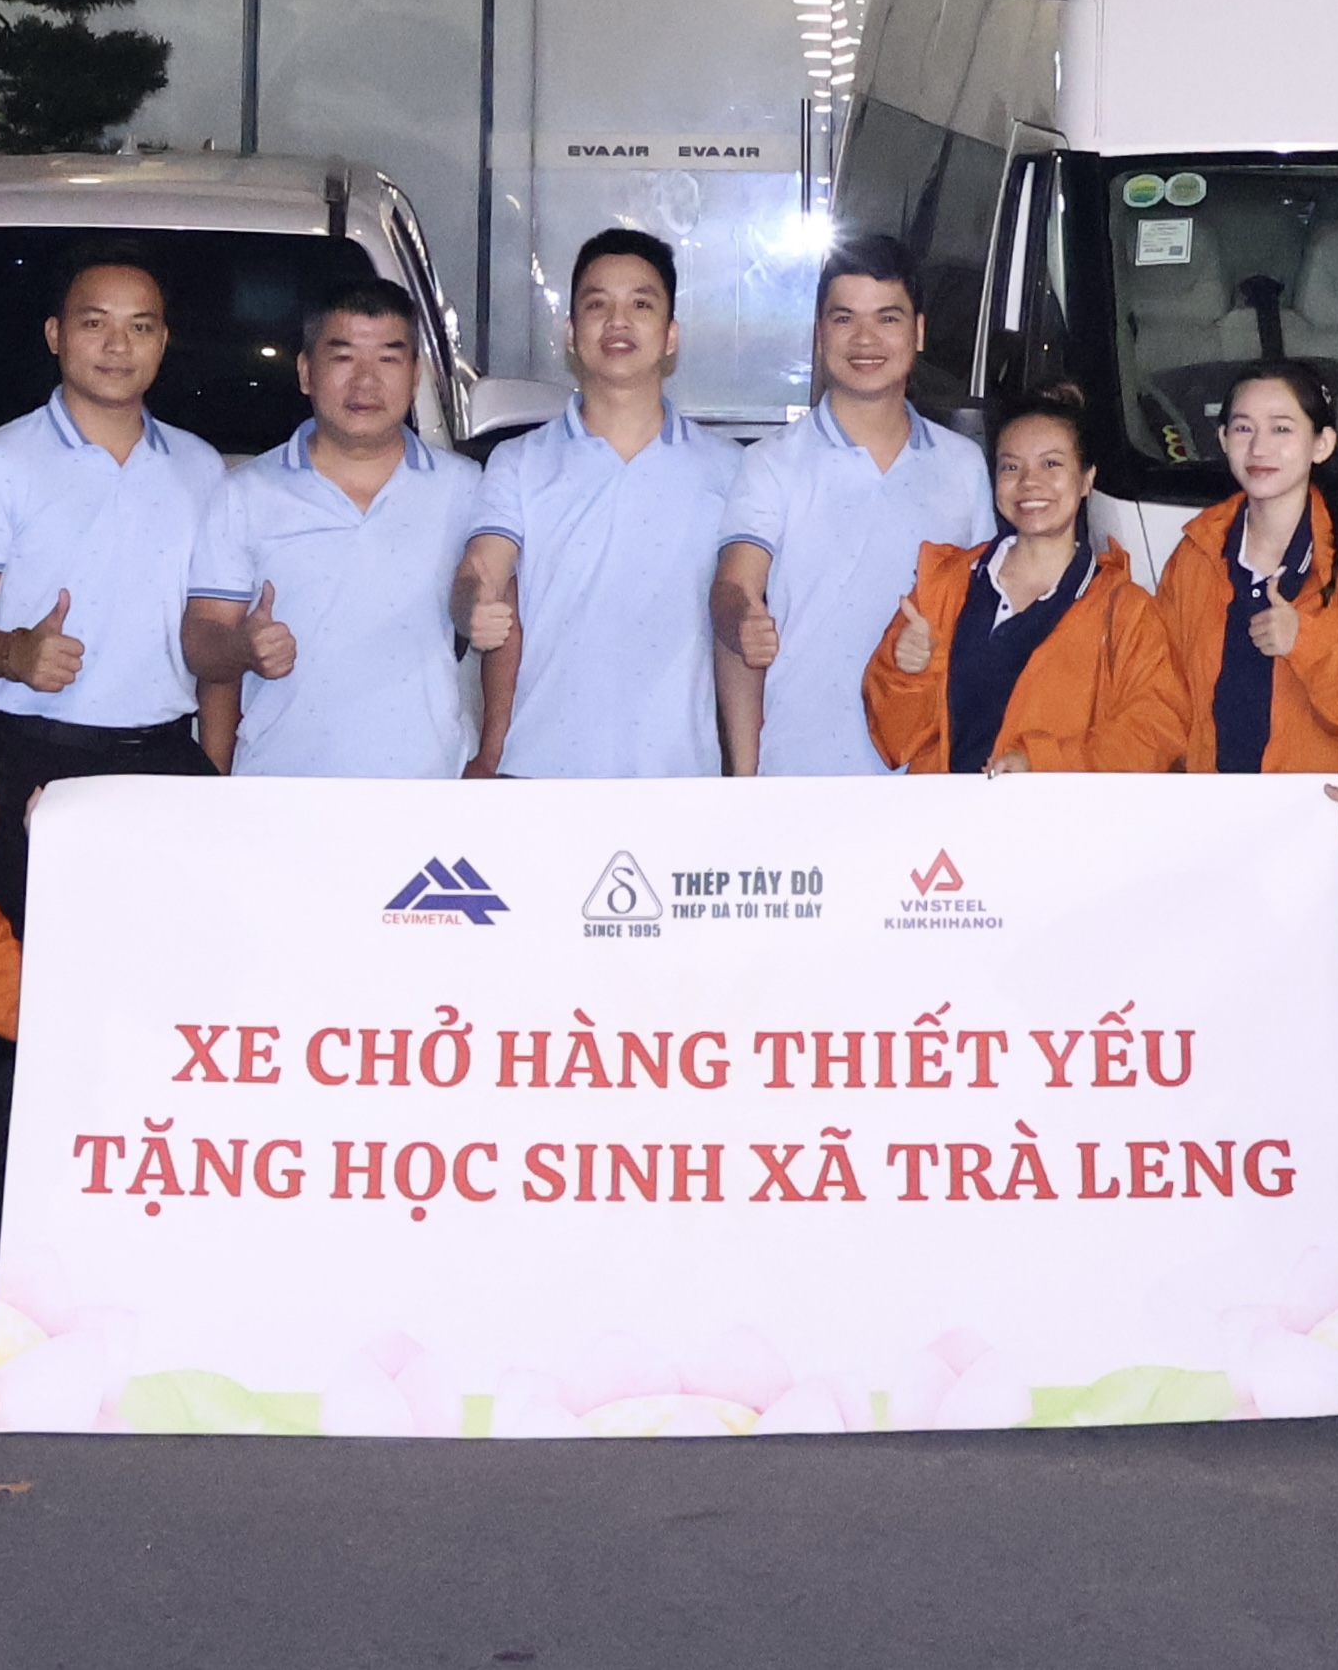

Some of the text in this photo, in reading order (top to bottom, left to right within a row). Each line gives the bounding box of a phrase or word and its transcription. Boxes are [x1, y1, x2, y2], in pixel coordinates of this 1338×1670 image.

[671, 865, 823, 896] THÉP TÂY ĐÔ
[671, 902, 706, 919] THÉP
[900, 899, 987, 912] VNSTEEL
[382, 912, 463, 925] CEVIMETAL
[884, 917, 1003, 929] KIMKHIHANOI
[583, 923, 662, 938] SINCE 1995
[171, 999, 1197, 1090] XE CHỞ HÀNG THIẾT YẾU
[72, 1116, 1298, 1222] TẶNG HỌC SINH XÃ TRÀ LENG
